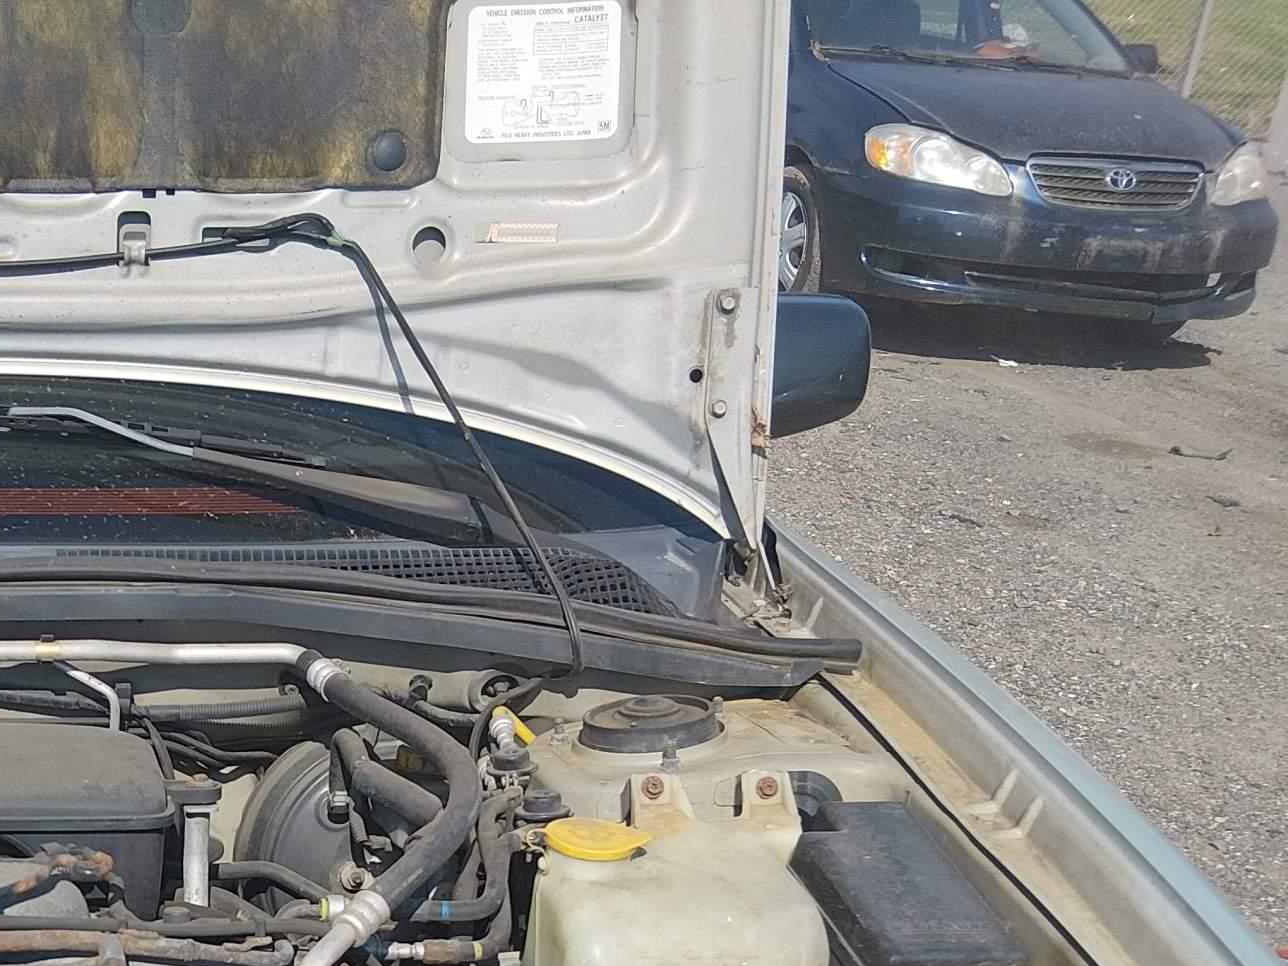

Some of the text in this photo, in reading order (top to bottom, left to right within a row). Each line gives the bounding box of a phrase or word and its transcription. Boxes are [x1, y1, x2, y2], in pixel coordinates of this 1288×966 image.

[511, 8, 536, 16] EMISSION
[539, 7, 564, 15] CONTROL
[567, 5, 604, 14] INFORMATION
[574, 14, 609, 23] CATALYST
